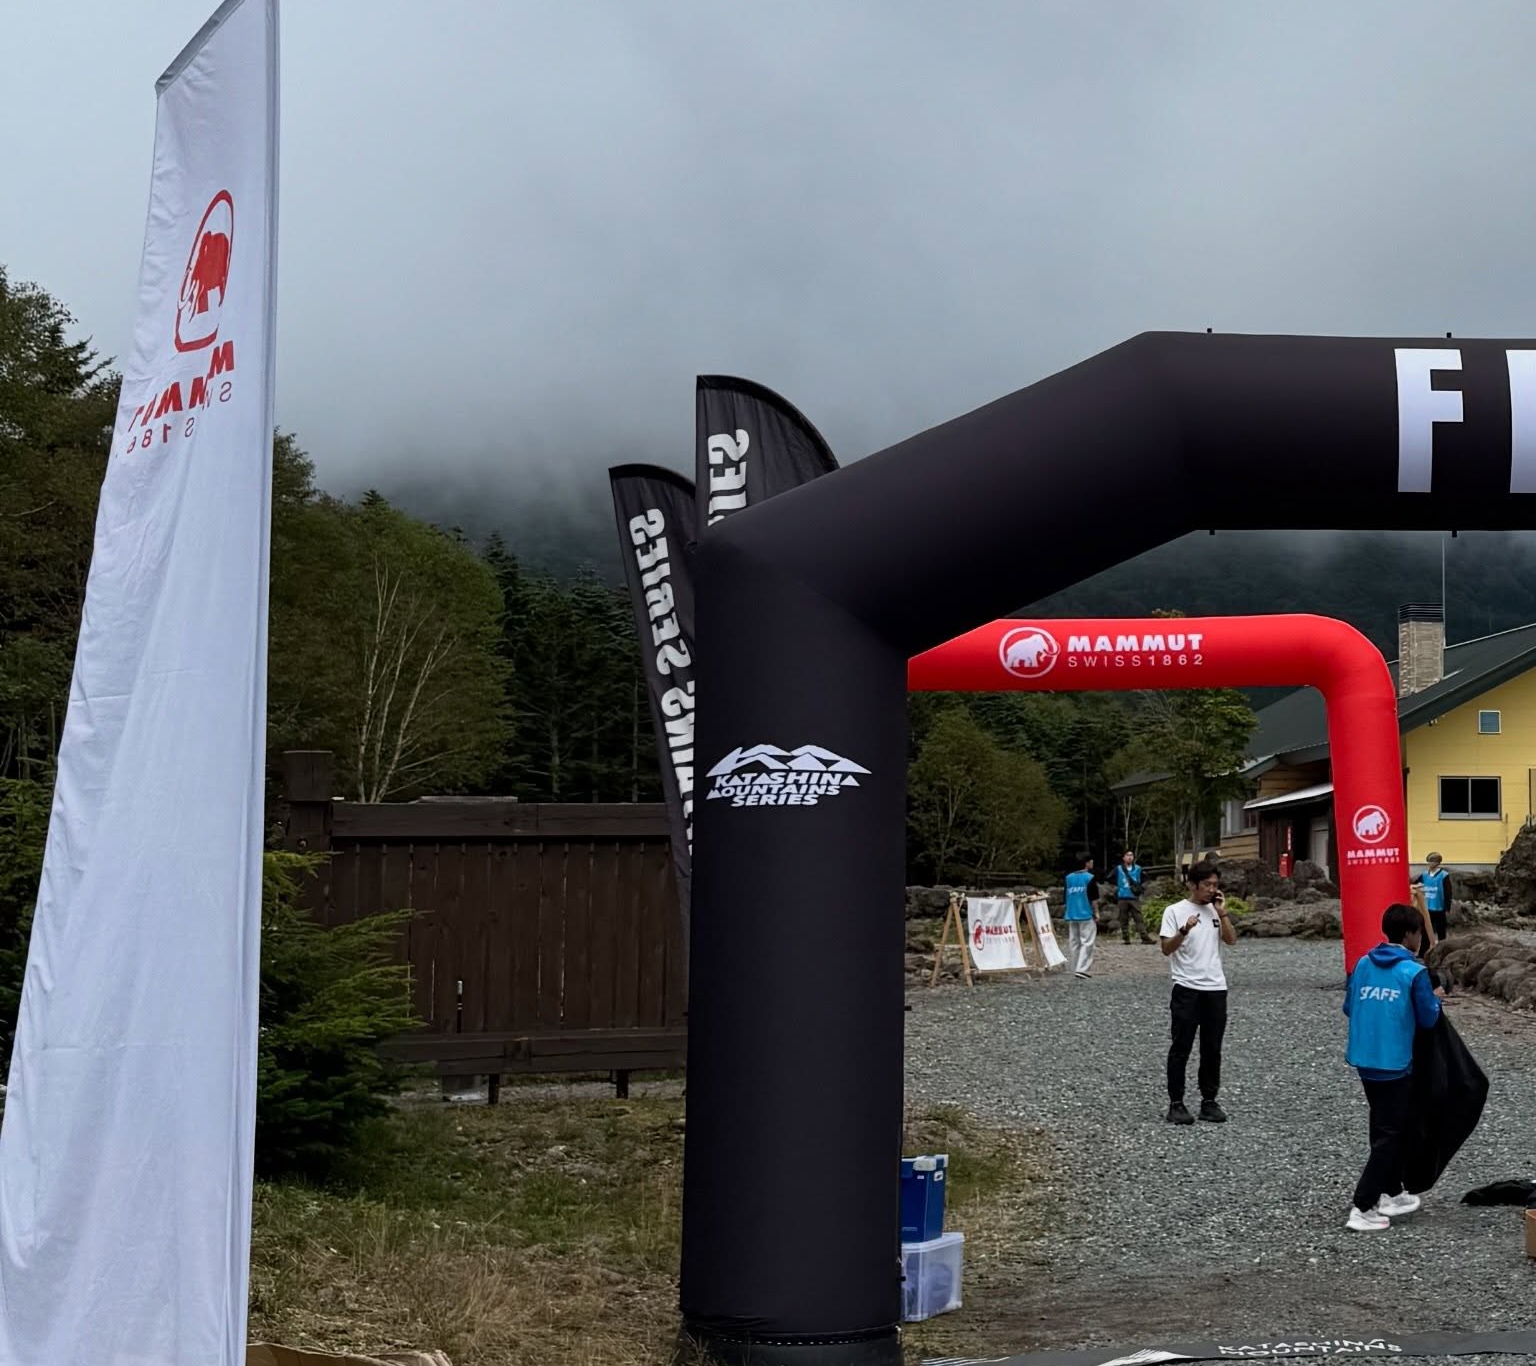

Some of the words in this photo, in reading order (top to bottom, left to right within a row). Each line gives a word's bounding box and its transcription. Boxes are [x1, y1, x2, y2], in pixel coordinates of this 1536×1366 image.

[1067, 633, 1204, 652] MAMMUT
[715, 772, 860, 788] KATASHINA
[706, 785, 841, 800] MOUNTAINS
[730, 794, 820, 808] SERIES
[1347, 847, 1399, 859] MAMMUT
